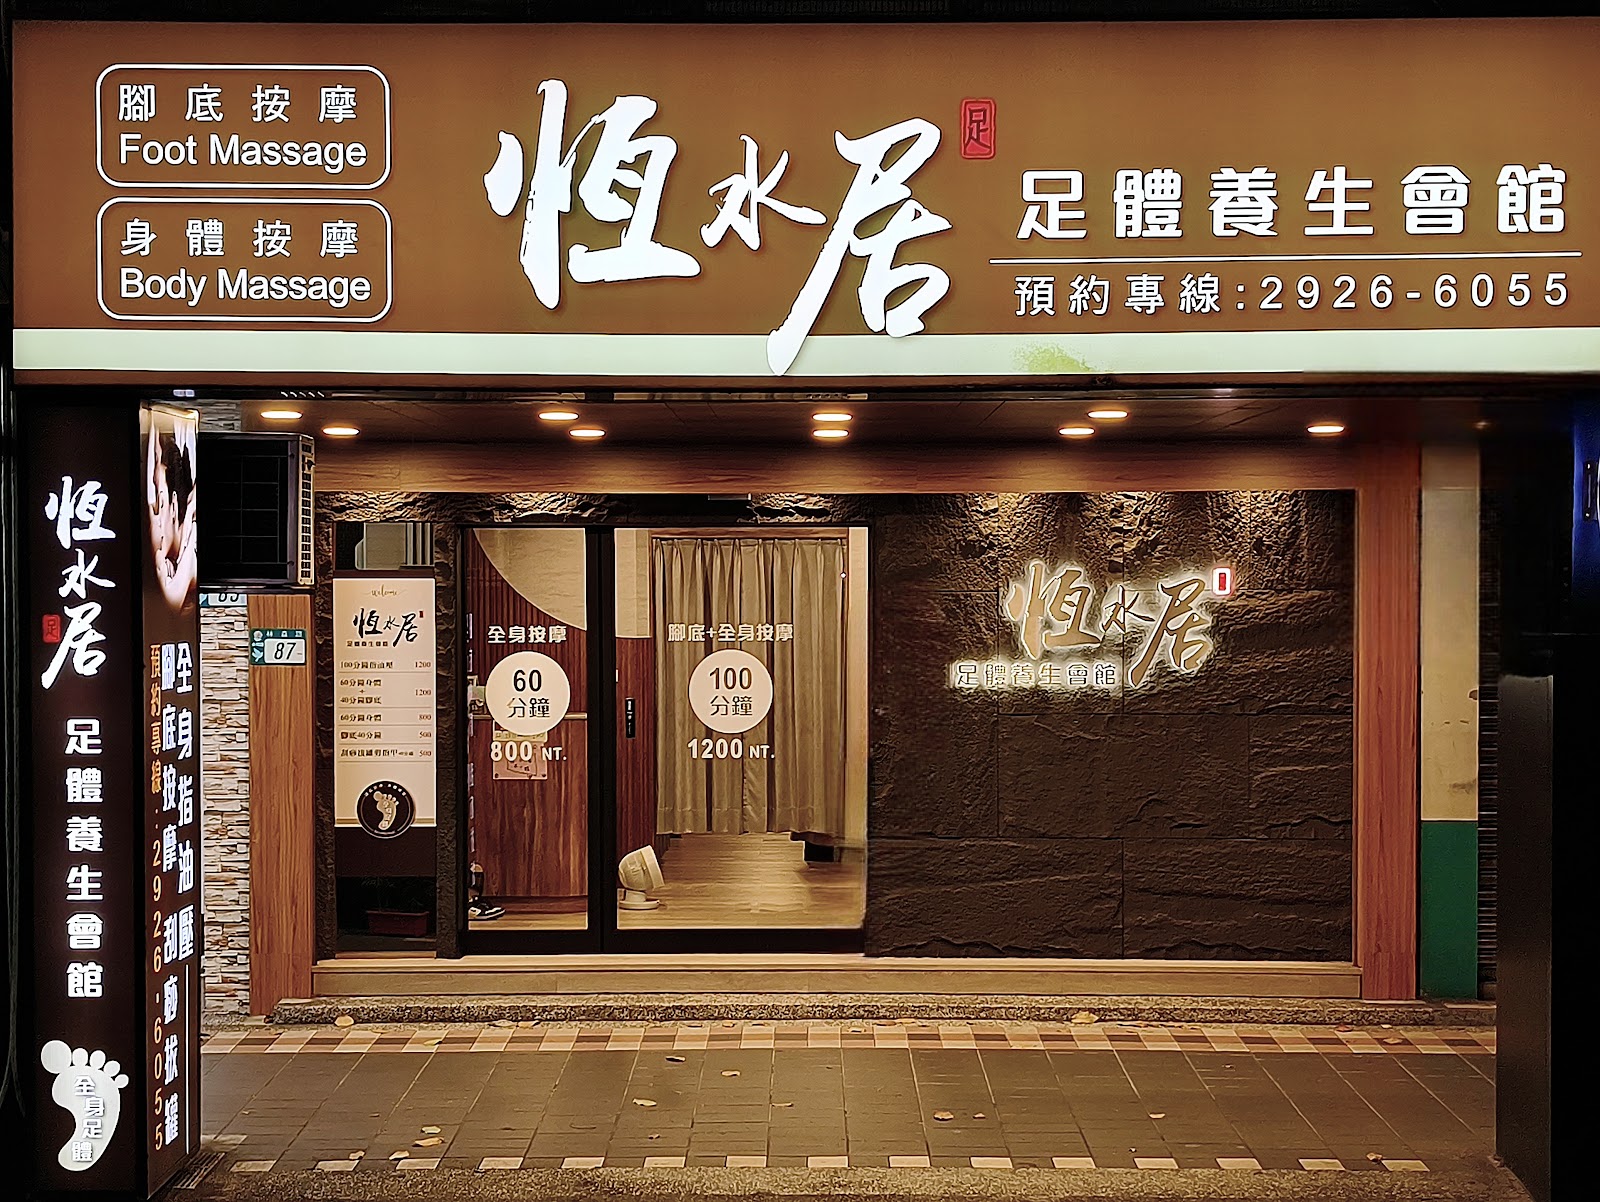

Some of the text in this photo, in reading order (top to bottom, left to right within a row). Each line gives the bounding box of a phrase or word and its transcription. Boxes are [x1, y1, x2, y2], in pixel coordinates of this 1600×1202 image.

[119, 84, 357, 122] 腳底按摩
[120, 133, 367, 173] Foot Massage
[1016, 163, 1567, 240] 足體養生會館
[120, 217, 358, 257] 身體按摩
[120, 268, 371, 307] Body Massage
[487, 626, 567, 644] 全身按摩
[668, 623, 793, 642] 腳底+全身按摩
[274, 642, 297, 660] 87
[513, 669, 542, 692] 60
[709, 667, 752, 690] 100
[957, 663, 1117, 686] 足體養生會館
[507, 697, 551, 718] 分鐘
[710, 695, 753, 716] 分鐘
[490, 741, 568, 761] 800 NT.
[687, 738, 775, 759] 1200 NT.
[65, 718, 104, 998] 足體養生會館
[73, 1075, 105, 1162] 全身足體
